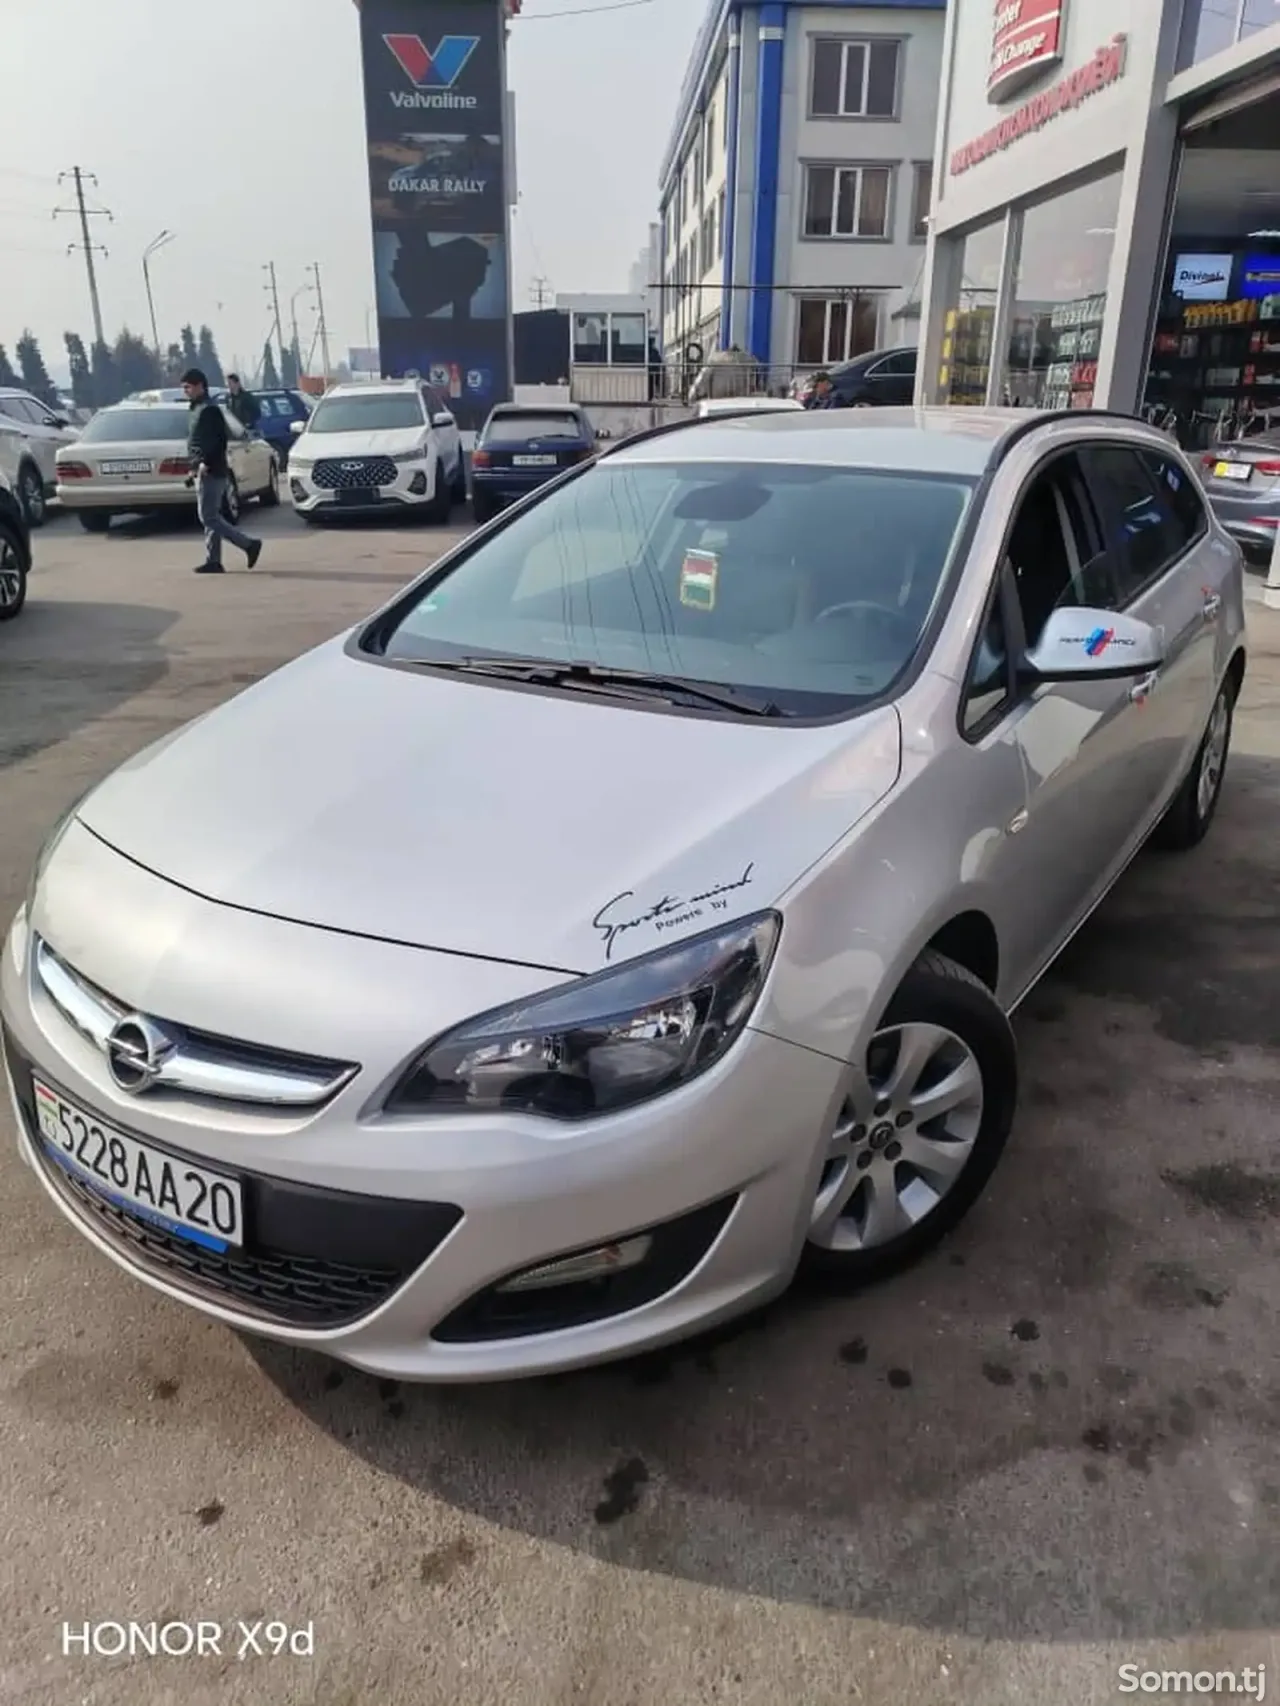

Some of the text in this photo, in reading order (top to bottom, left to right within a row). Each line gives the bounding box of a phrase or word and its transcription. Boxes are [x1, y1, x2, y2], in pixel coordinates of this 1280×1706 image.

[389, 91, 478, 109] Valvoline
[387, 178, 486, 193] DAKAR RALLY
